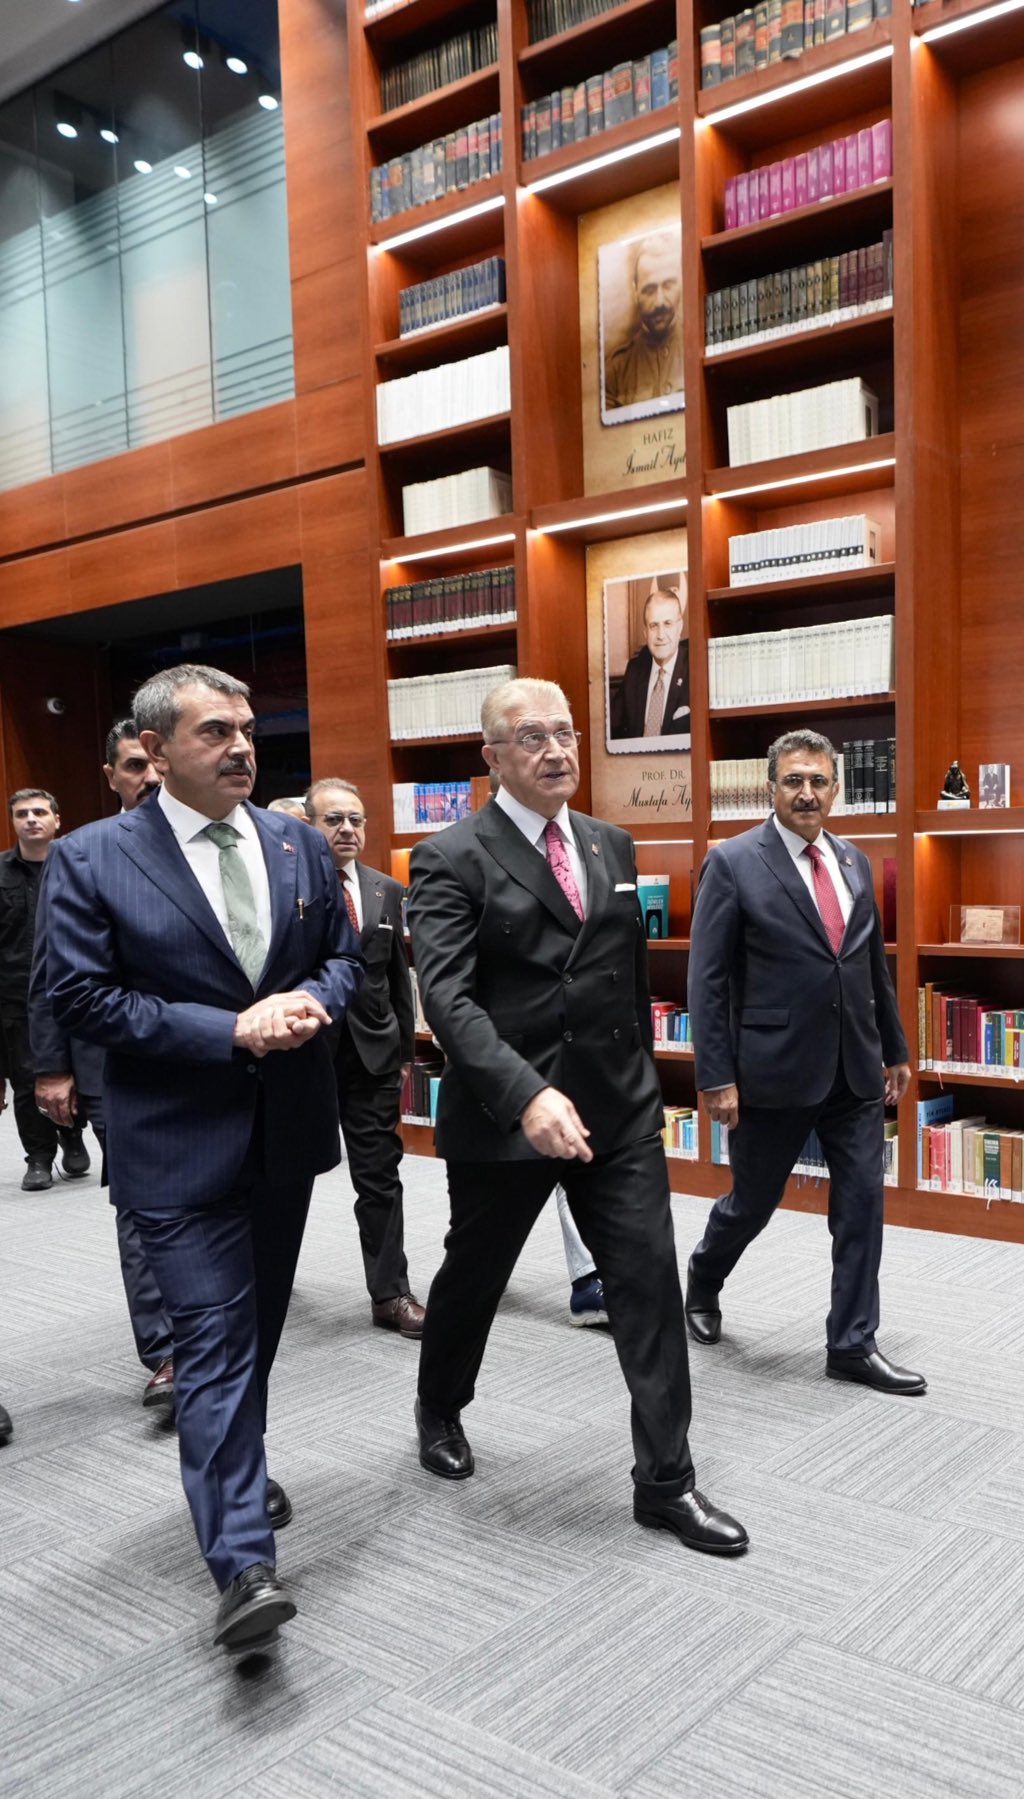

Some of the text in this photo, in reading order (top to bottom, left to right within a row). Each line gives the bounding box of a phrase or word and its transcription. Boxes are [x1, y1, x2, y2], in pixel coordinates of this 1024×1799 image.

[643, 427, 674, 446] HAFIZ
[622, 448, 660, 477] İsmail
[623, 784, 693, 812] Mustafa Ay
